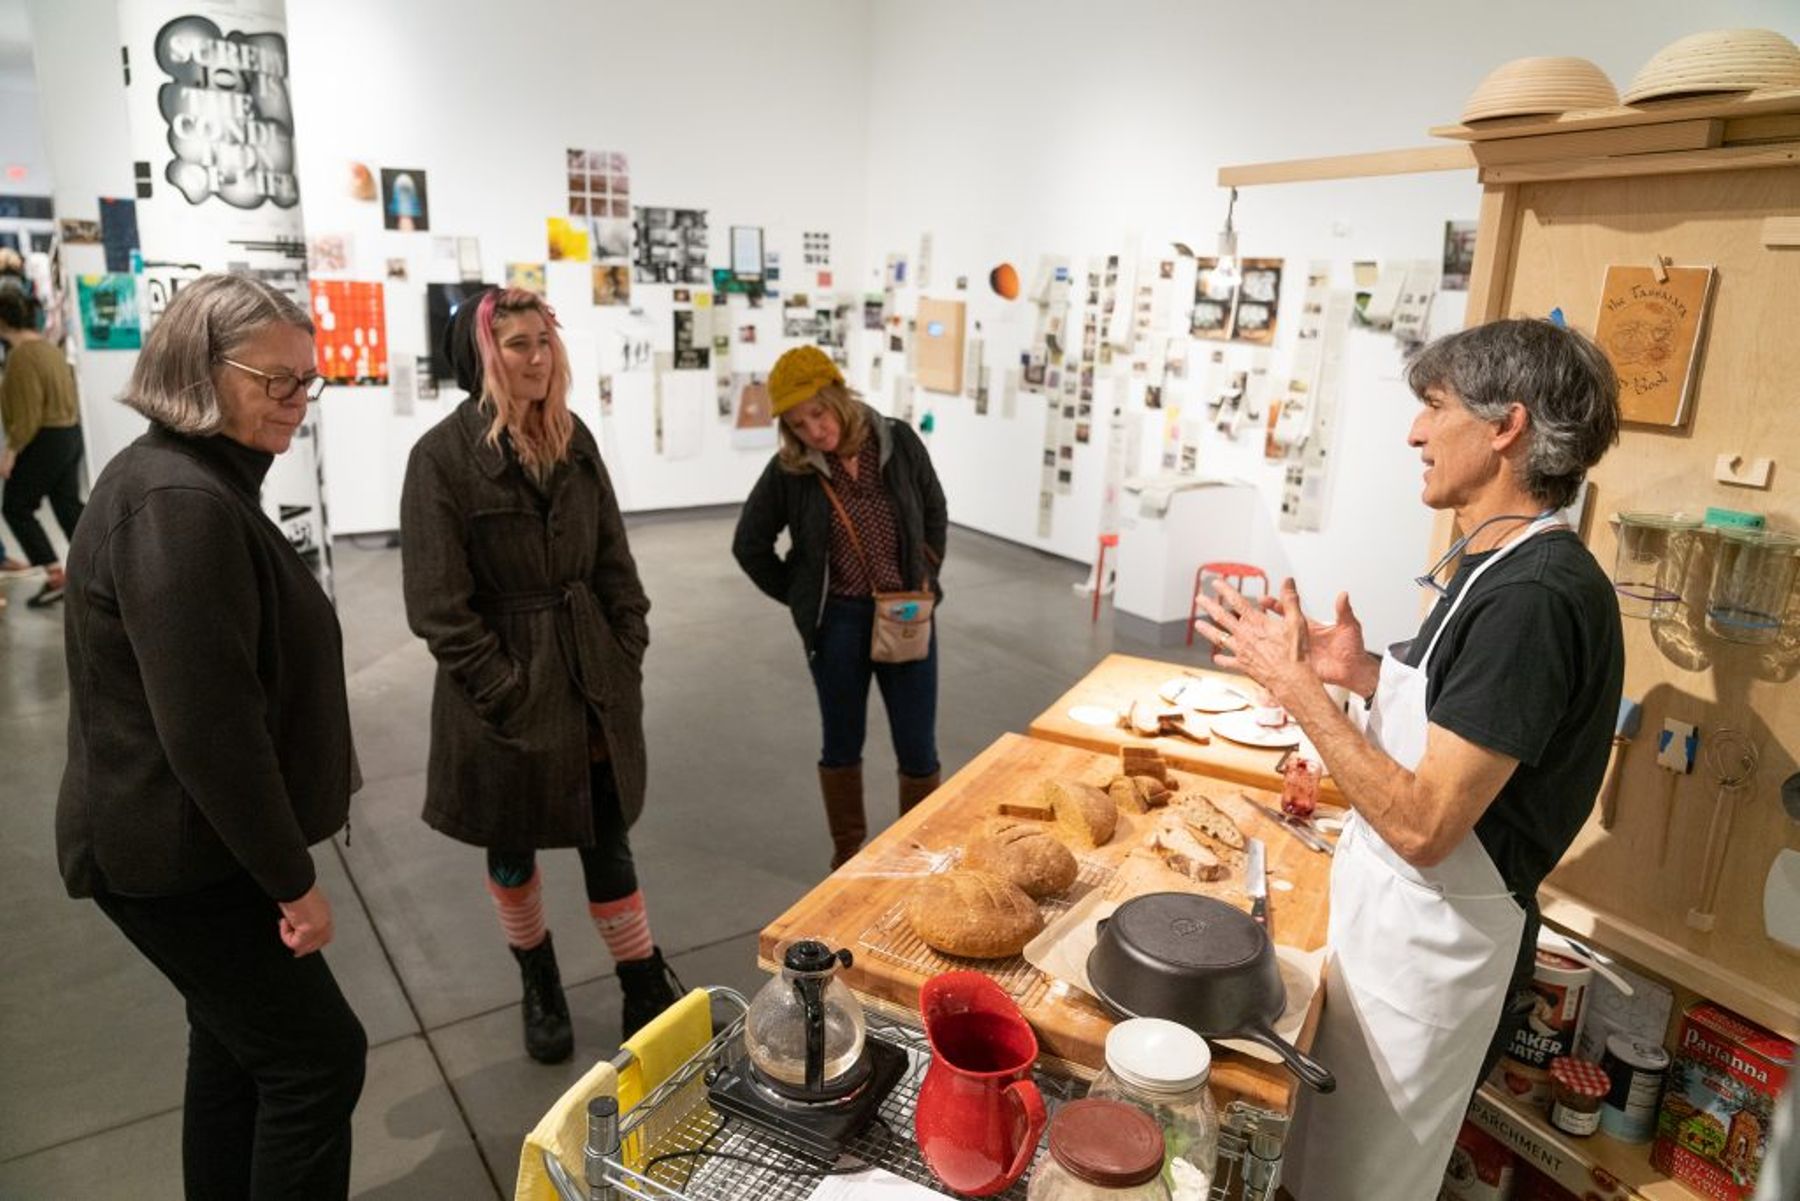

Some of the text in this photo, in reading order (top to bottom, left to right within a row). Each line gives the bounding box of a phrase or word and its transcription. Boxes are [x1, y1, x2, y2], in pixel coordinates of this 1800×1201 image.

[180, 86, 256, 121] THE
[1515, 1029, 1563, 1055] AKER
[1684, 1025, 1769, 1084] Partanna
[1470, 1102, 1563, 1171] PARCHMENT
